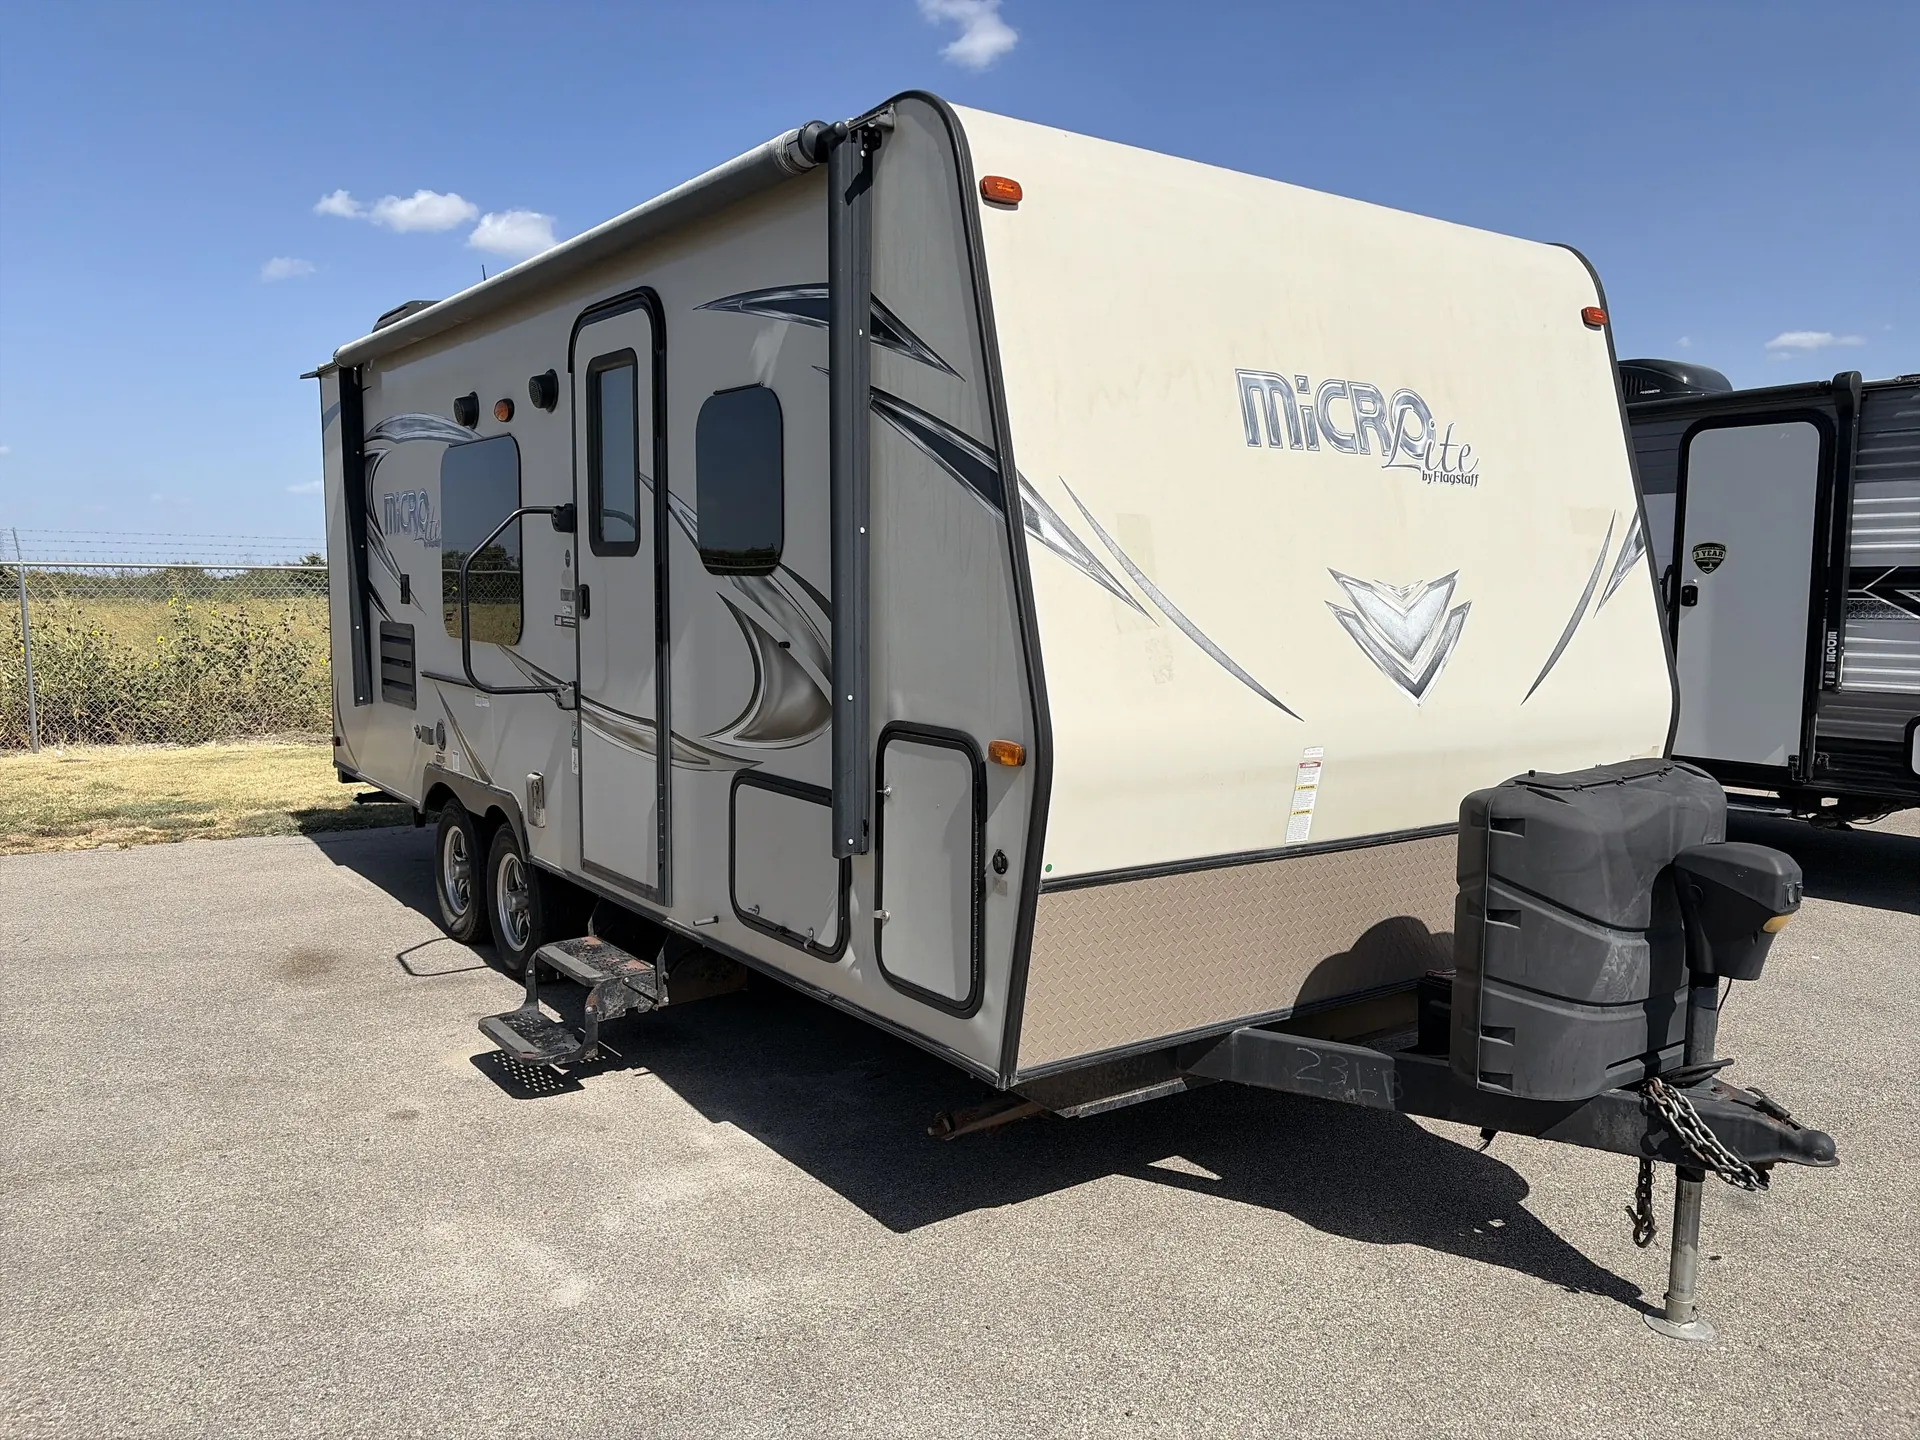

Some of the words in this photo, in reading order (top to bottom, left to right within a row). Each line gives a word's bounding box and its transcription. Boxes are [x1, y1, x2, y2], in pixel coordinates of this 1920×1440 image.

[1381, 407, 1479, 473] Lite
[1433, 471, 1479, 487] Flagstaff
[1701, 550, 1724, 558] YEAR
[1826, 631, 1838, 662] EDGE
